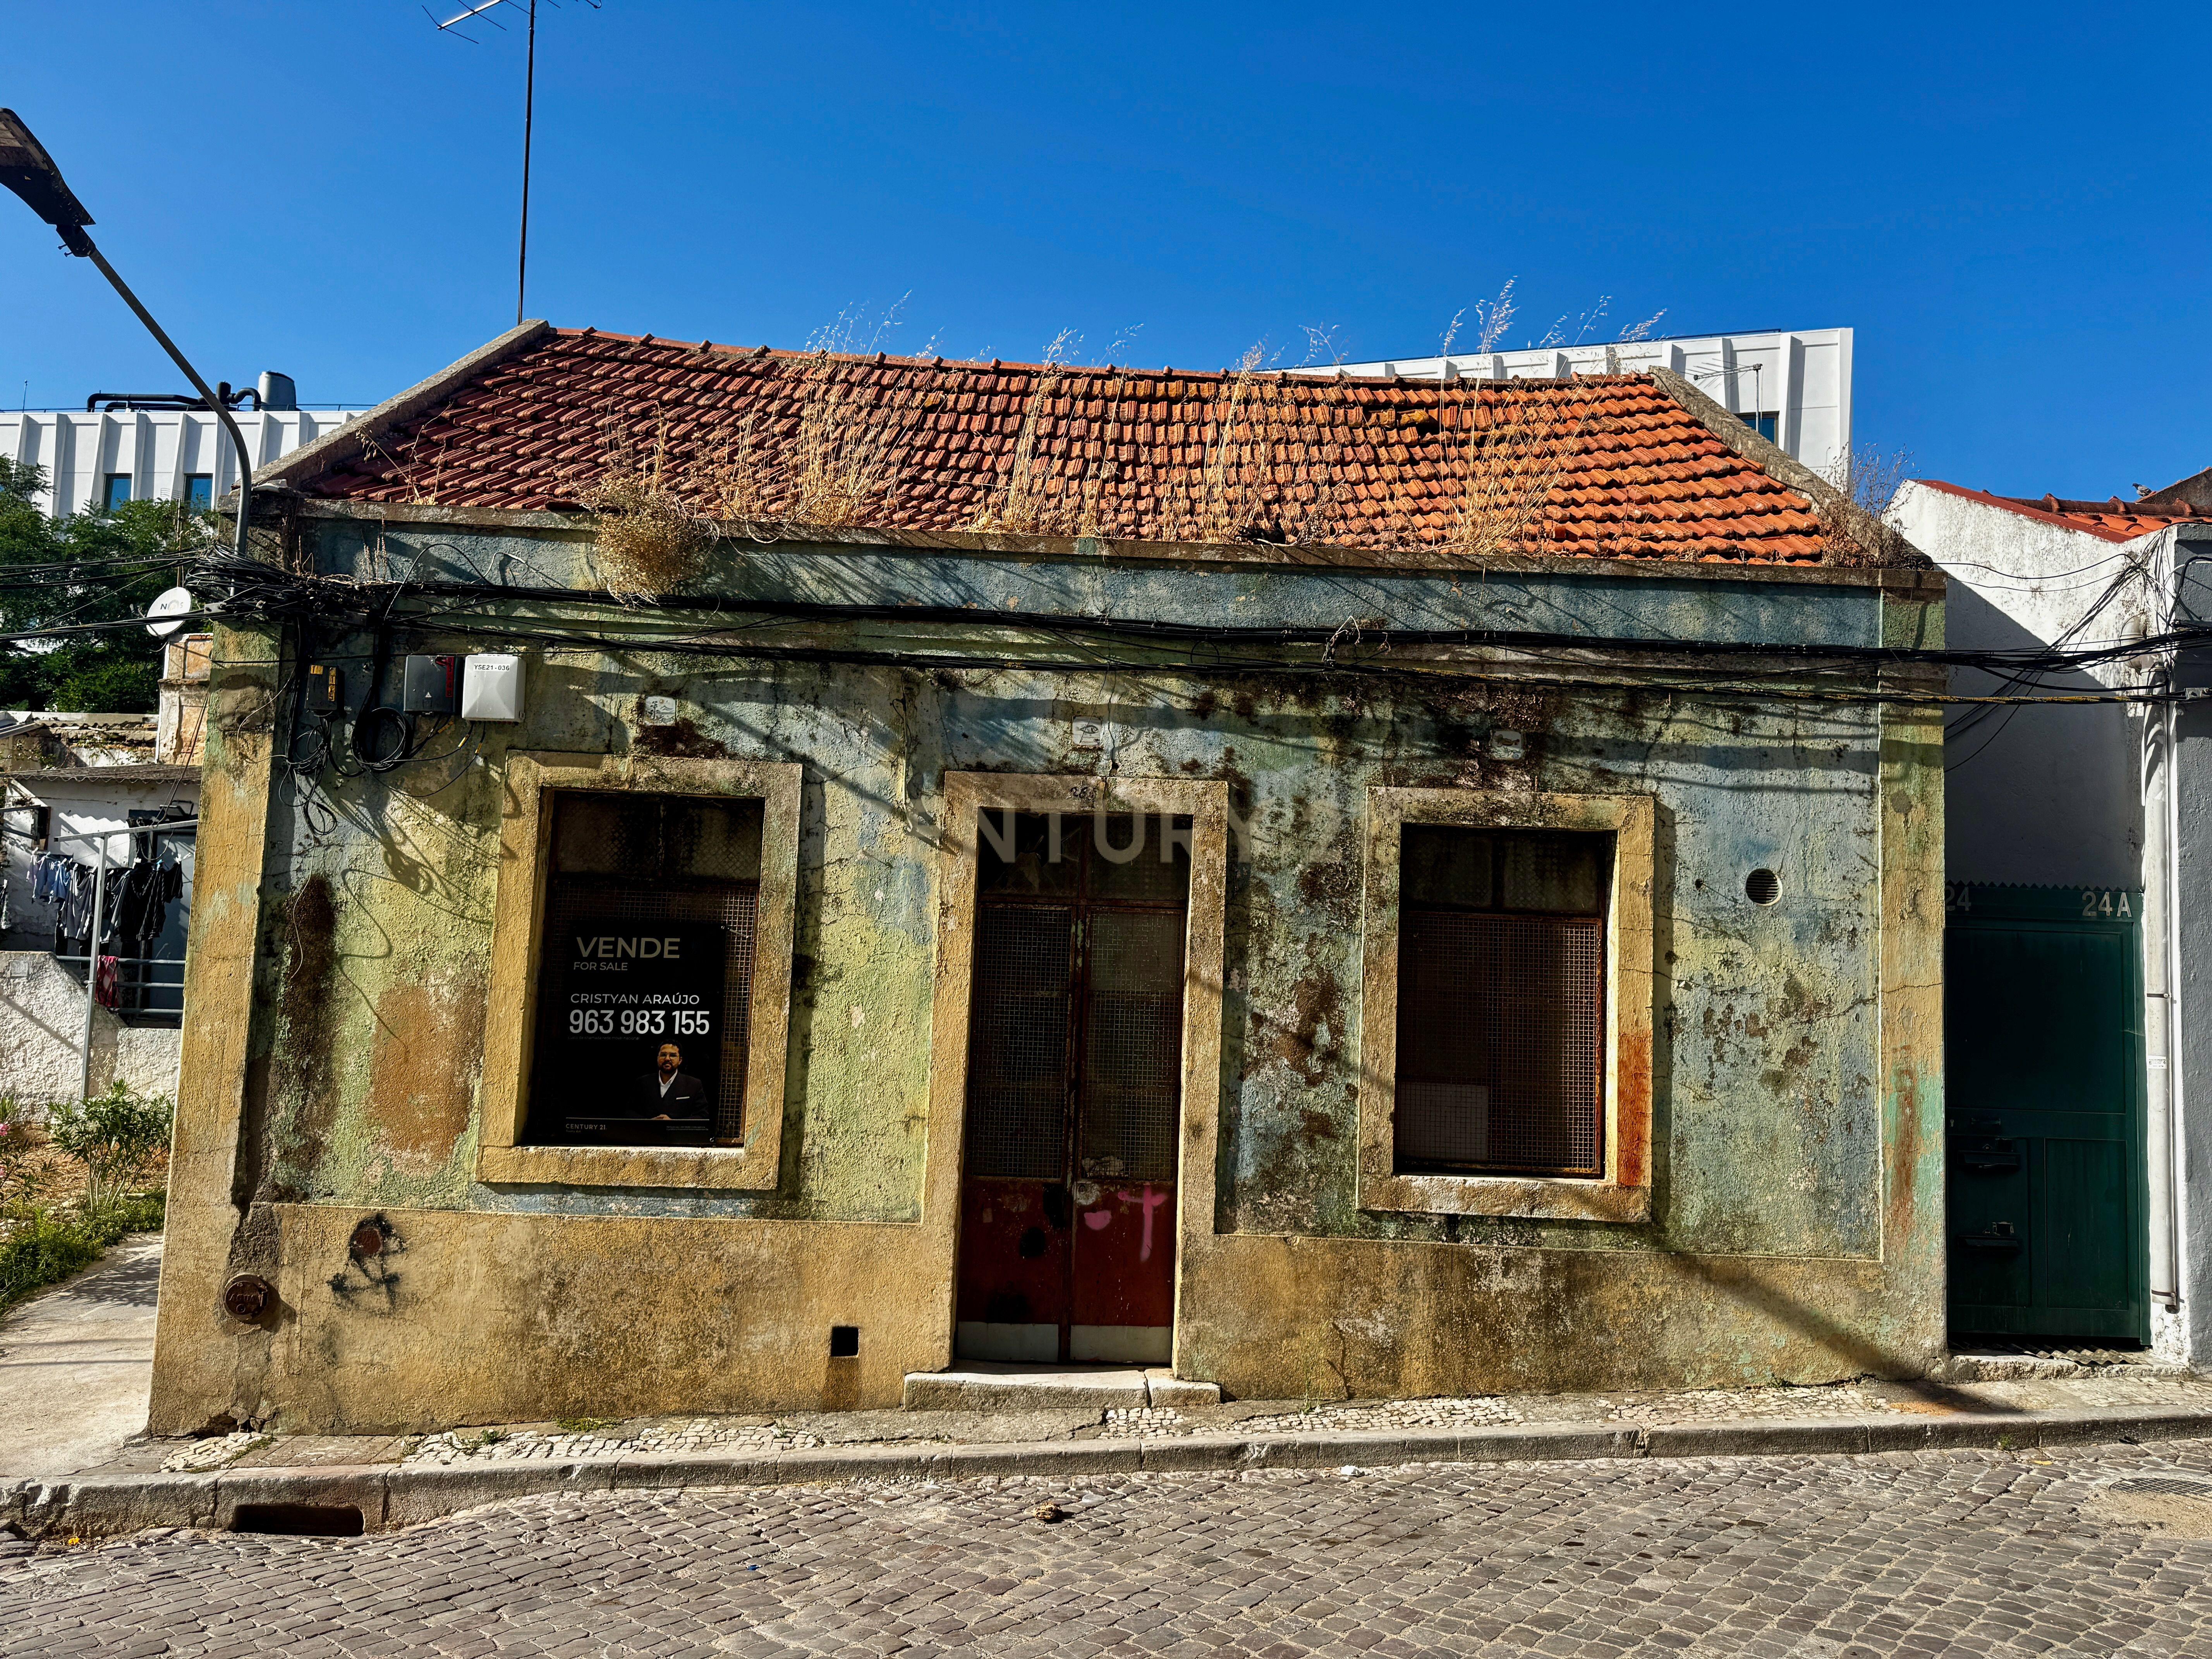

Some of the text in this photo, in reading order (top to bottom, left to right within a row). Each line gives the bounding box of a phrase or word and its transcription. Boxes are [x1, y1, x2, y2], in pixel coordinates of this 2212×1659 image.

[1944, 885, 1972, 912] 24
[576, 937, 680, 958] VENDE
[573, 962, 628, 971] FOR SALE
[570, 992, 700, 1005] CRISTYAN ARAÚJO
[569, 1009, 710, 1035] 963 983 155
